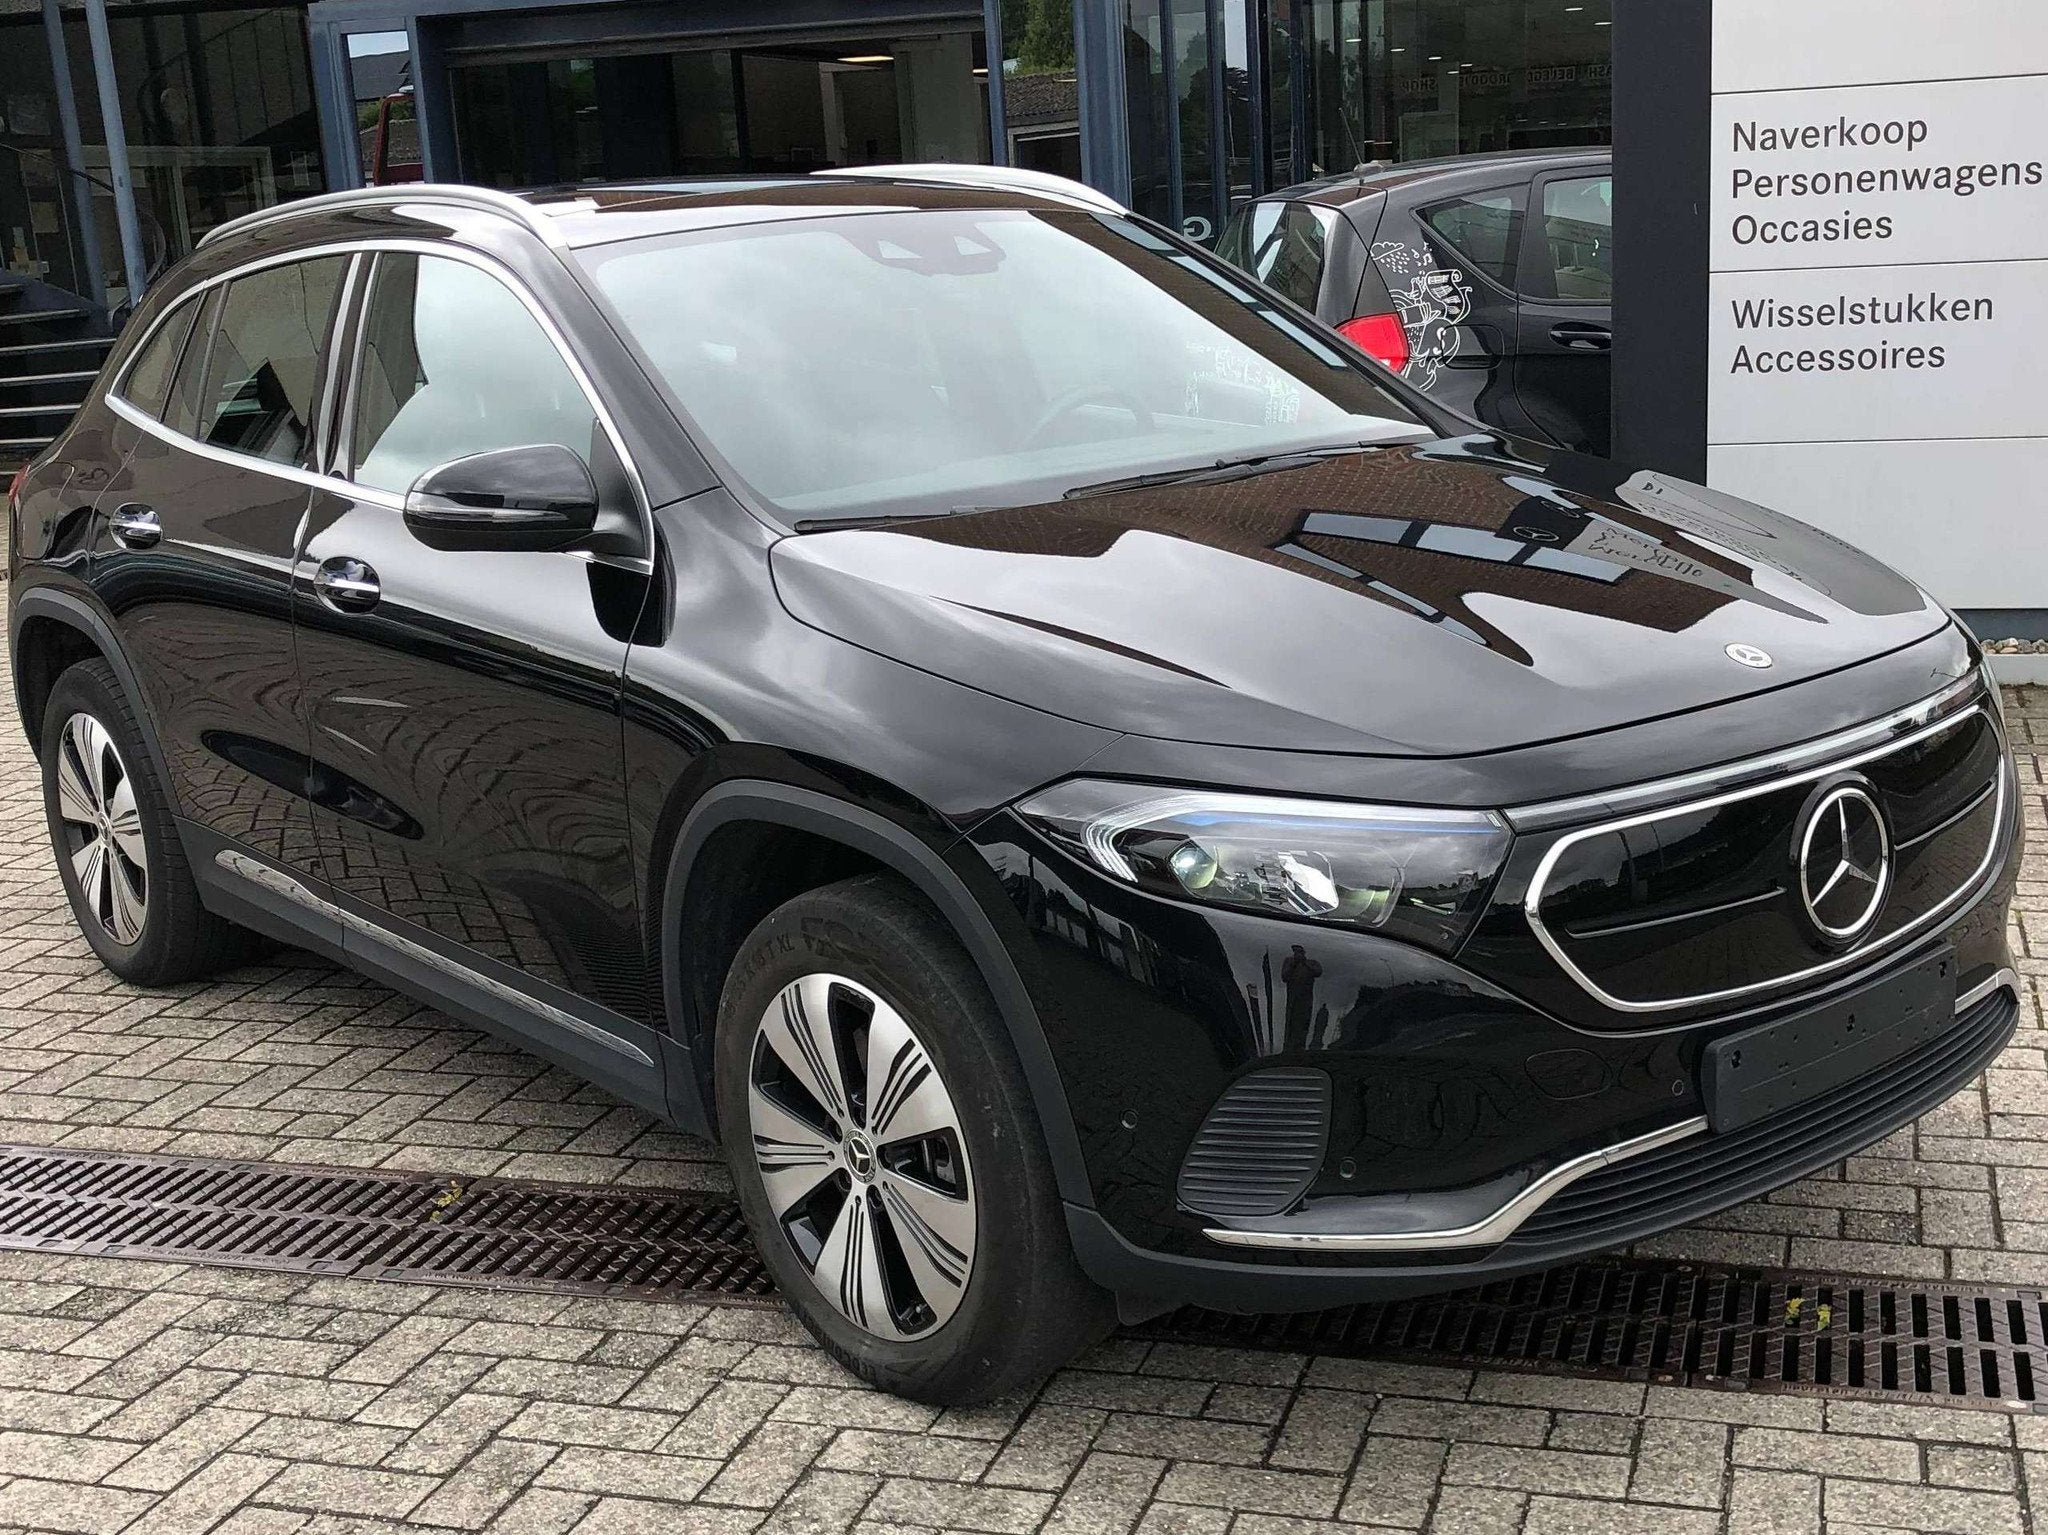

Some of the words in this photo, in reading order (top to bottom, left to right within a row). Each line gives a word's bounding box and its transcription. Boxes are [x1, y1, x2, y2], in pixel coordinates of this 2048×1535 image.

[1733, 116, 1928, 152] Naverkoop
[1732, 161, 2043, 199] Personenwagens
[1732, 210, 1892, 245] Occasies
[1731, 292, 1994, 329] Wisselstukken
[1730, 340, 1945, 374] Accessoires
